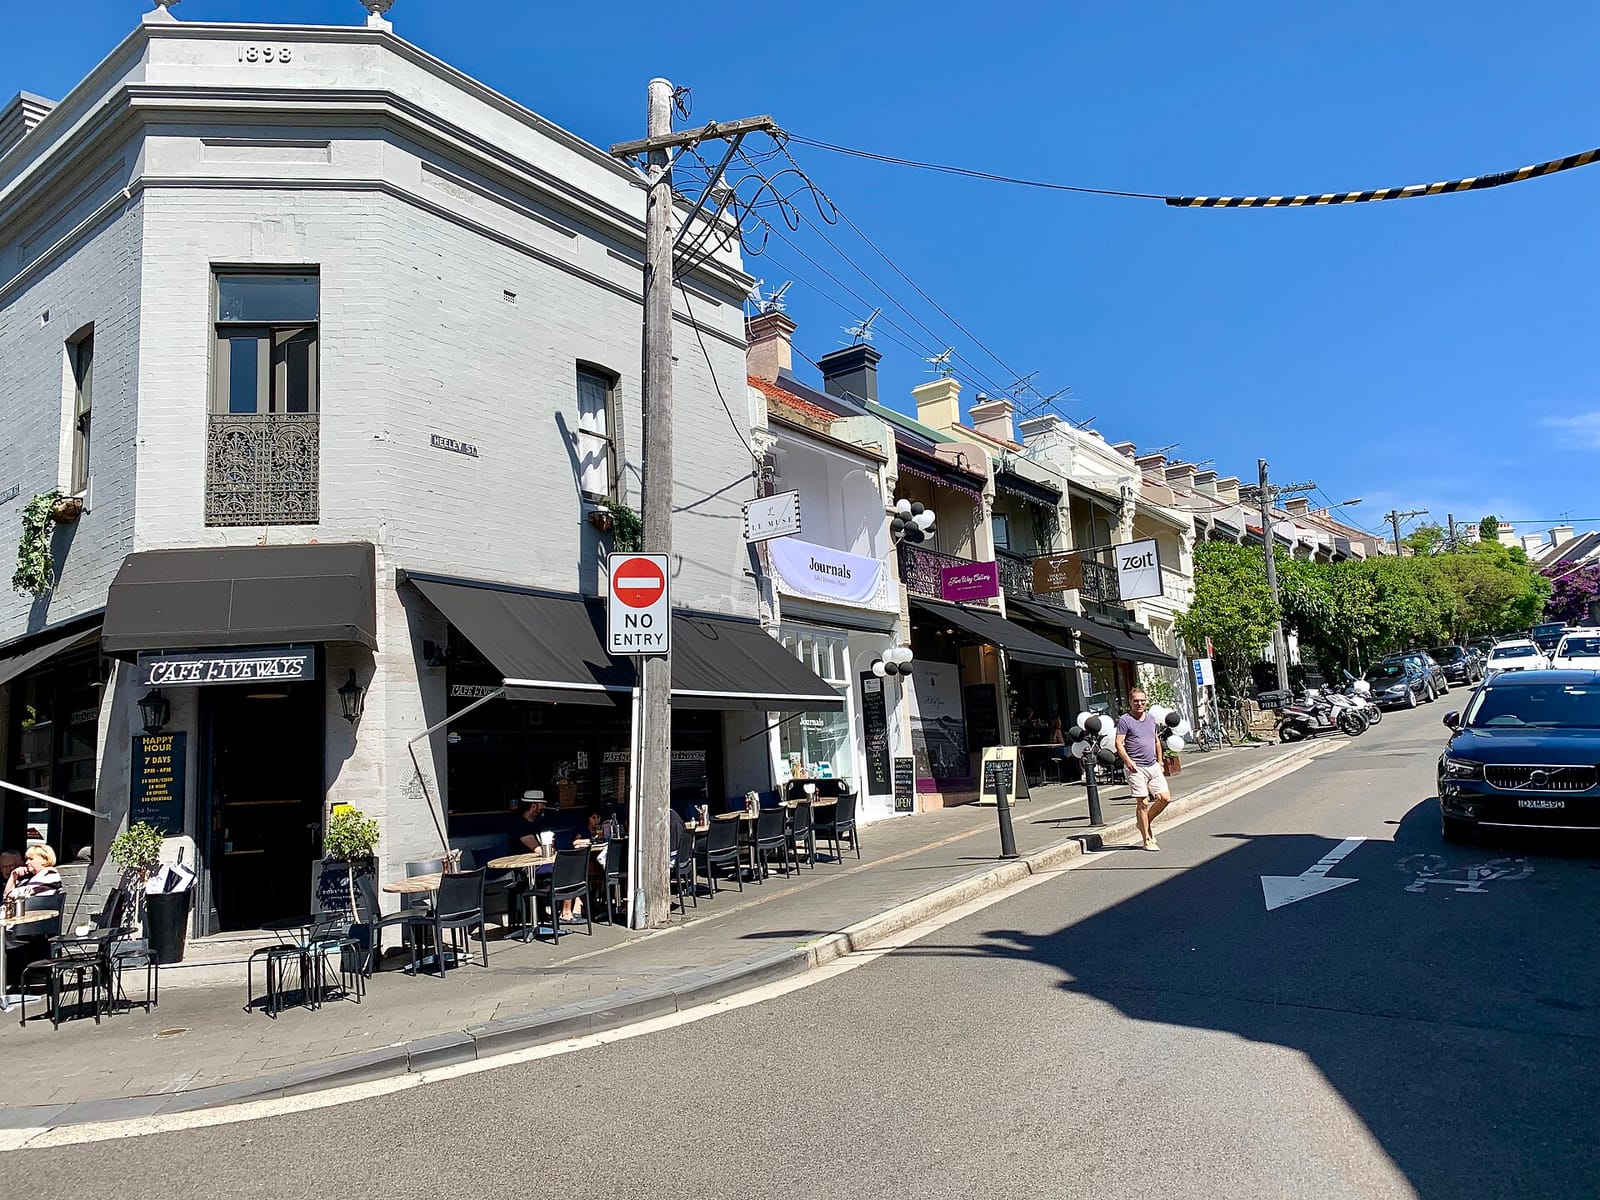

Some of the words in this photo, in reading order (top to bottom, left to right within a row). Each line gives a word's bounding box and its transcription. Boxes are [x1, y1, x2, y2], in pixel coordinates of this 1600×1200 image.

[237, 47, 292, 63] 1898
[434, 435, 463, 451] HEELEY
[809, 557, 851, 579] Journals
[625, 613, 653, 628] NO
[613, 633, 664, 646] ENTRY
[150, 661, 204, 684] CAFÉ
[142, 736, 174, 745] HAPPY
[144, 744, 172, 752] HOUR
[152, 756, 171, 764] DAYS
[895, 797, 911, 808] OPEN
